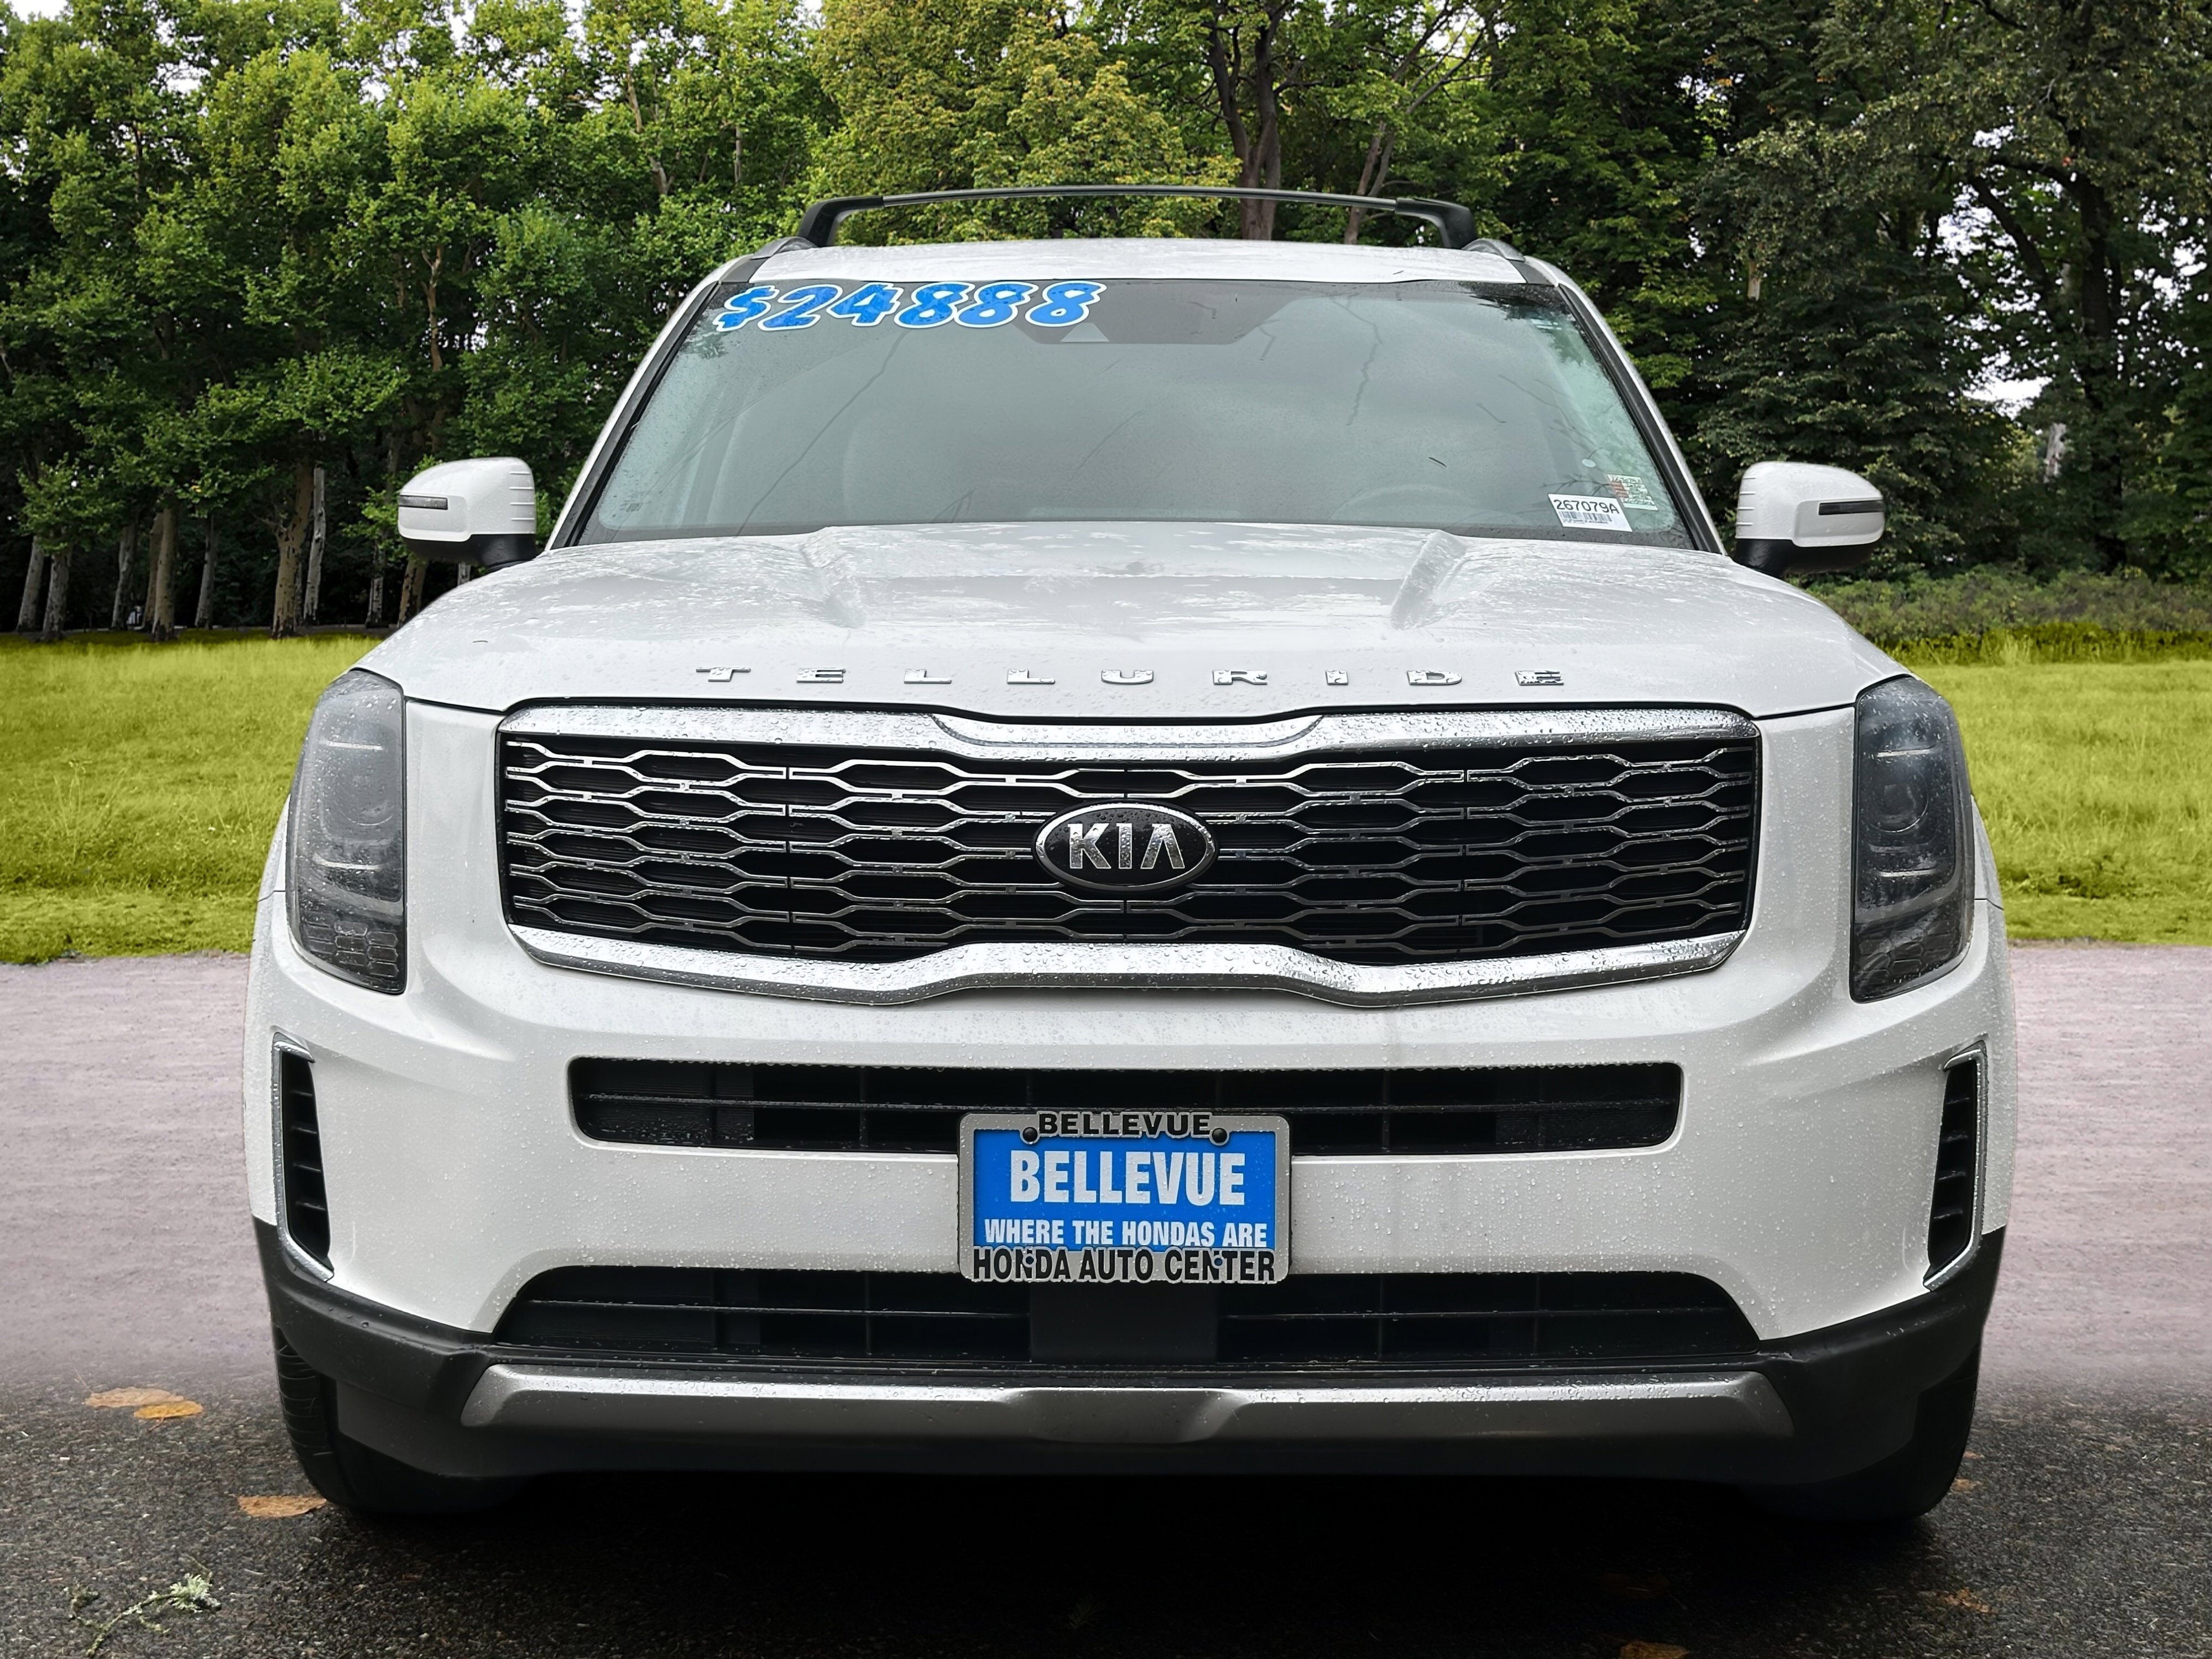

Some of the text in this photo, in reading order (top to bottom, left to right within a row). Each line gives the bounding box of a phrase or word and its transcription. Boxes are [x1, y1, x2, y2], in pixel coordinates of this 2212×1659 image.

[714, 281, 1107, 332] $24888
[1553, 499, 1619, 514] 267079A
[696, 666, 1566, 686] TELLURIDE
[1068, 822, 1185, 870] KIA
[1039, 1113, 1211, 1135] BELLEVUE
[1010, 1150, 1245, 1205] BELLEVUE
[984, 1219, 1267, 1247] WHERE THE HONDAS ARE
[973, 1249, 1275, 1281] HONDA AUTO CENTER
